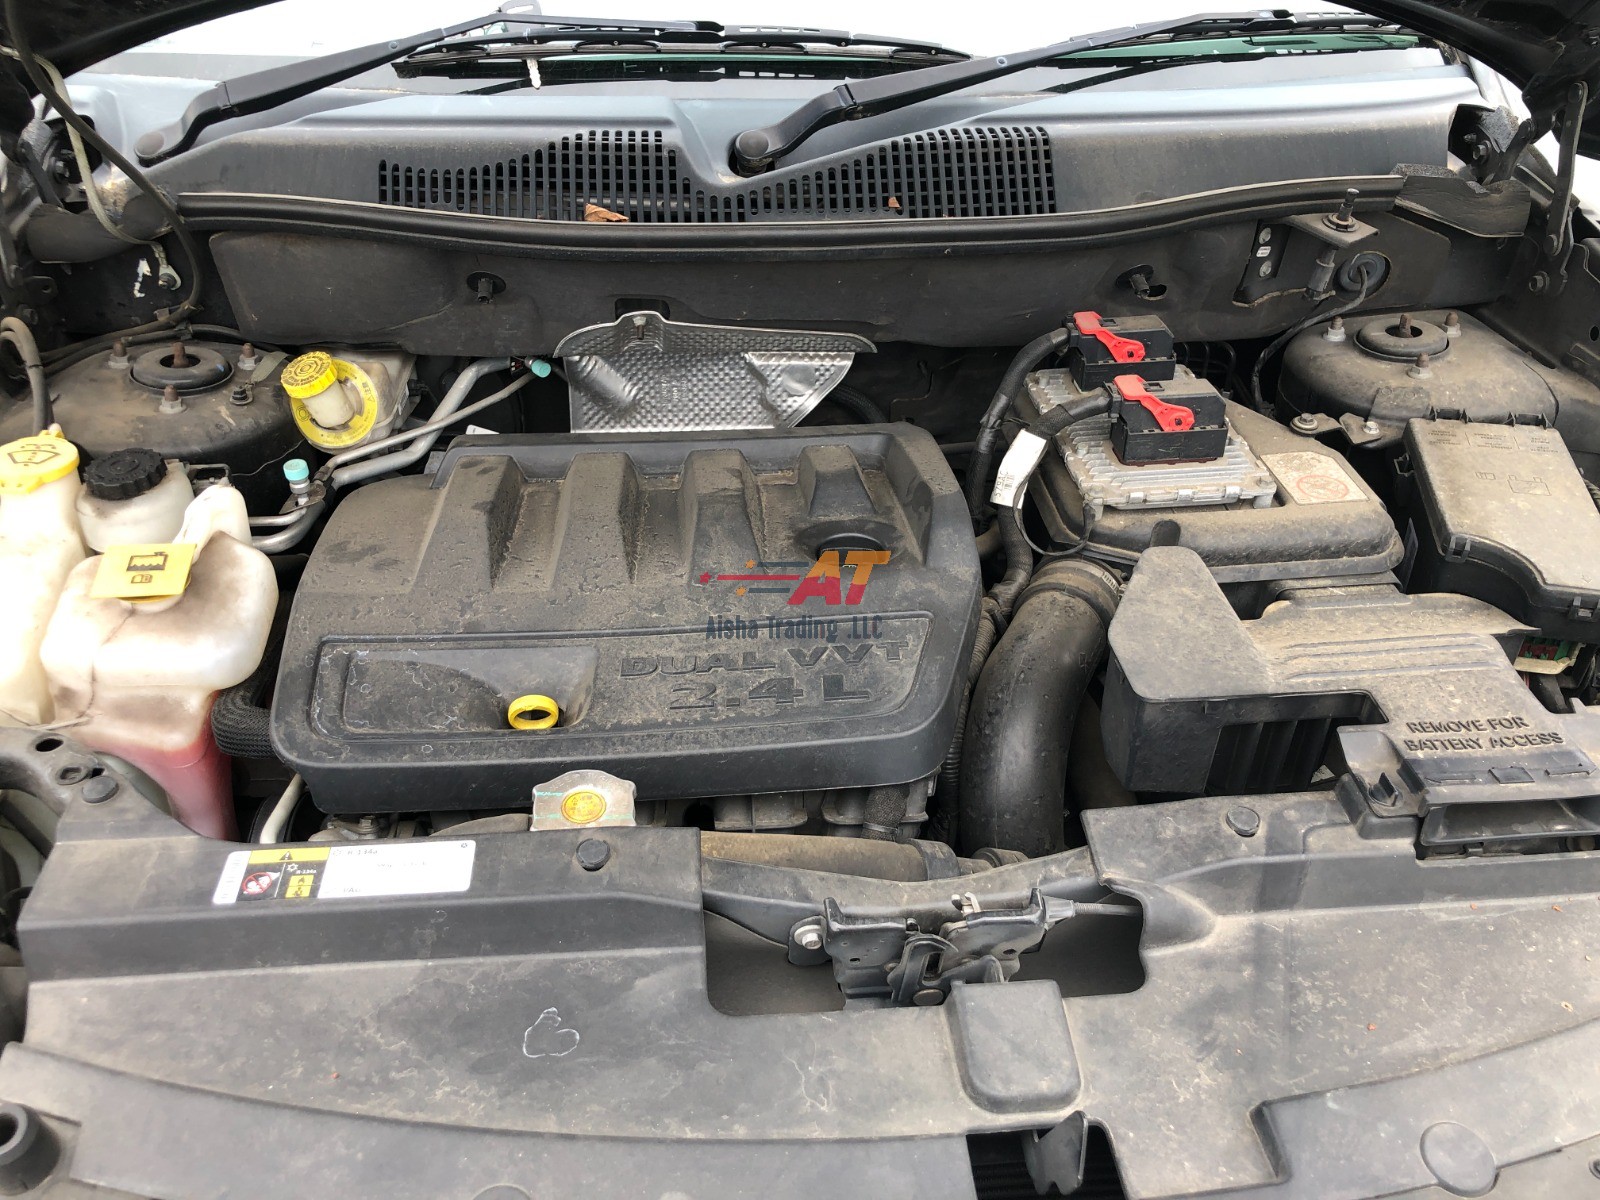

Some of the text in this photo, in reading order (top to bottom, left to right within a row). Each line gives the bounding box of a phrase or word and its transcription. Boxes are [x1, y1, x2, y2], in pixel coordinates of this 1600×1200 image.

[620, 641, 913, 677] DUAL VVT
[1406, 715, 1529, 734] REMOVE FOR
[1403, 732, 1565, 751] BATTERY ACCESS
